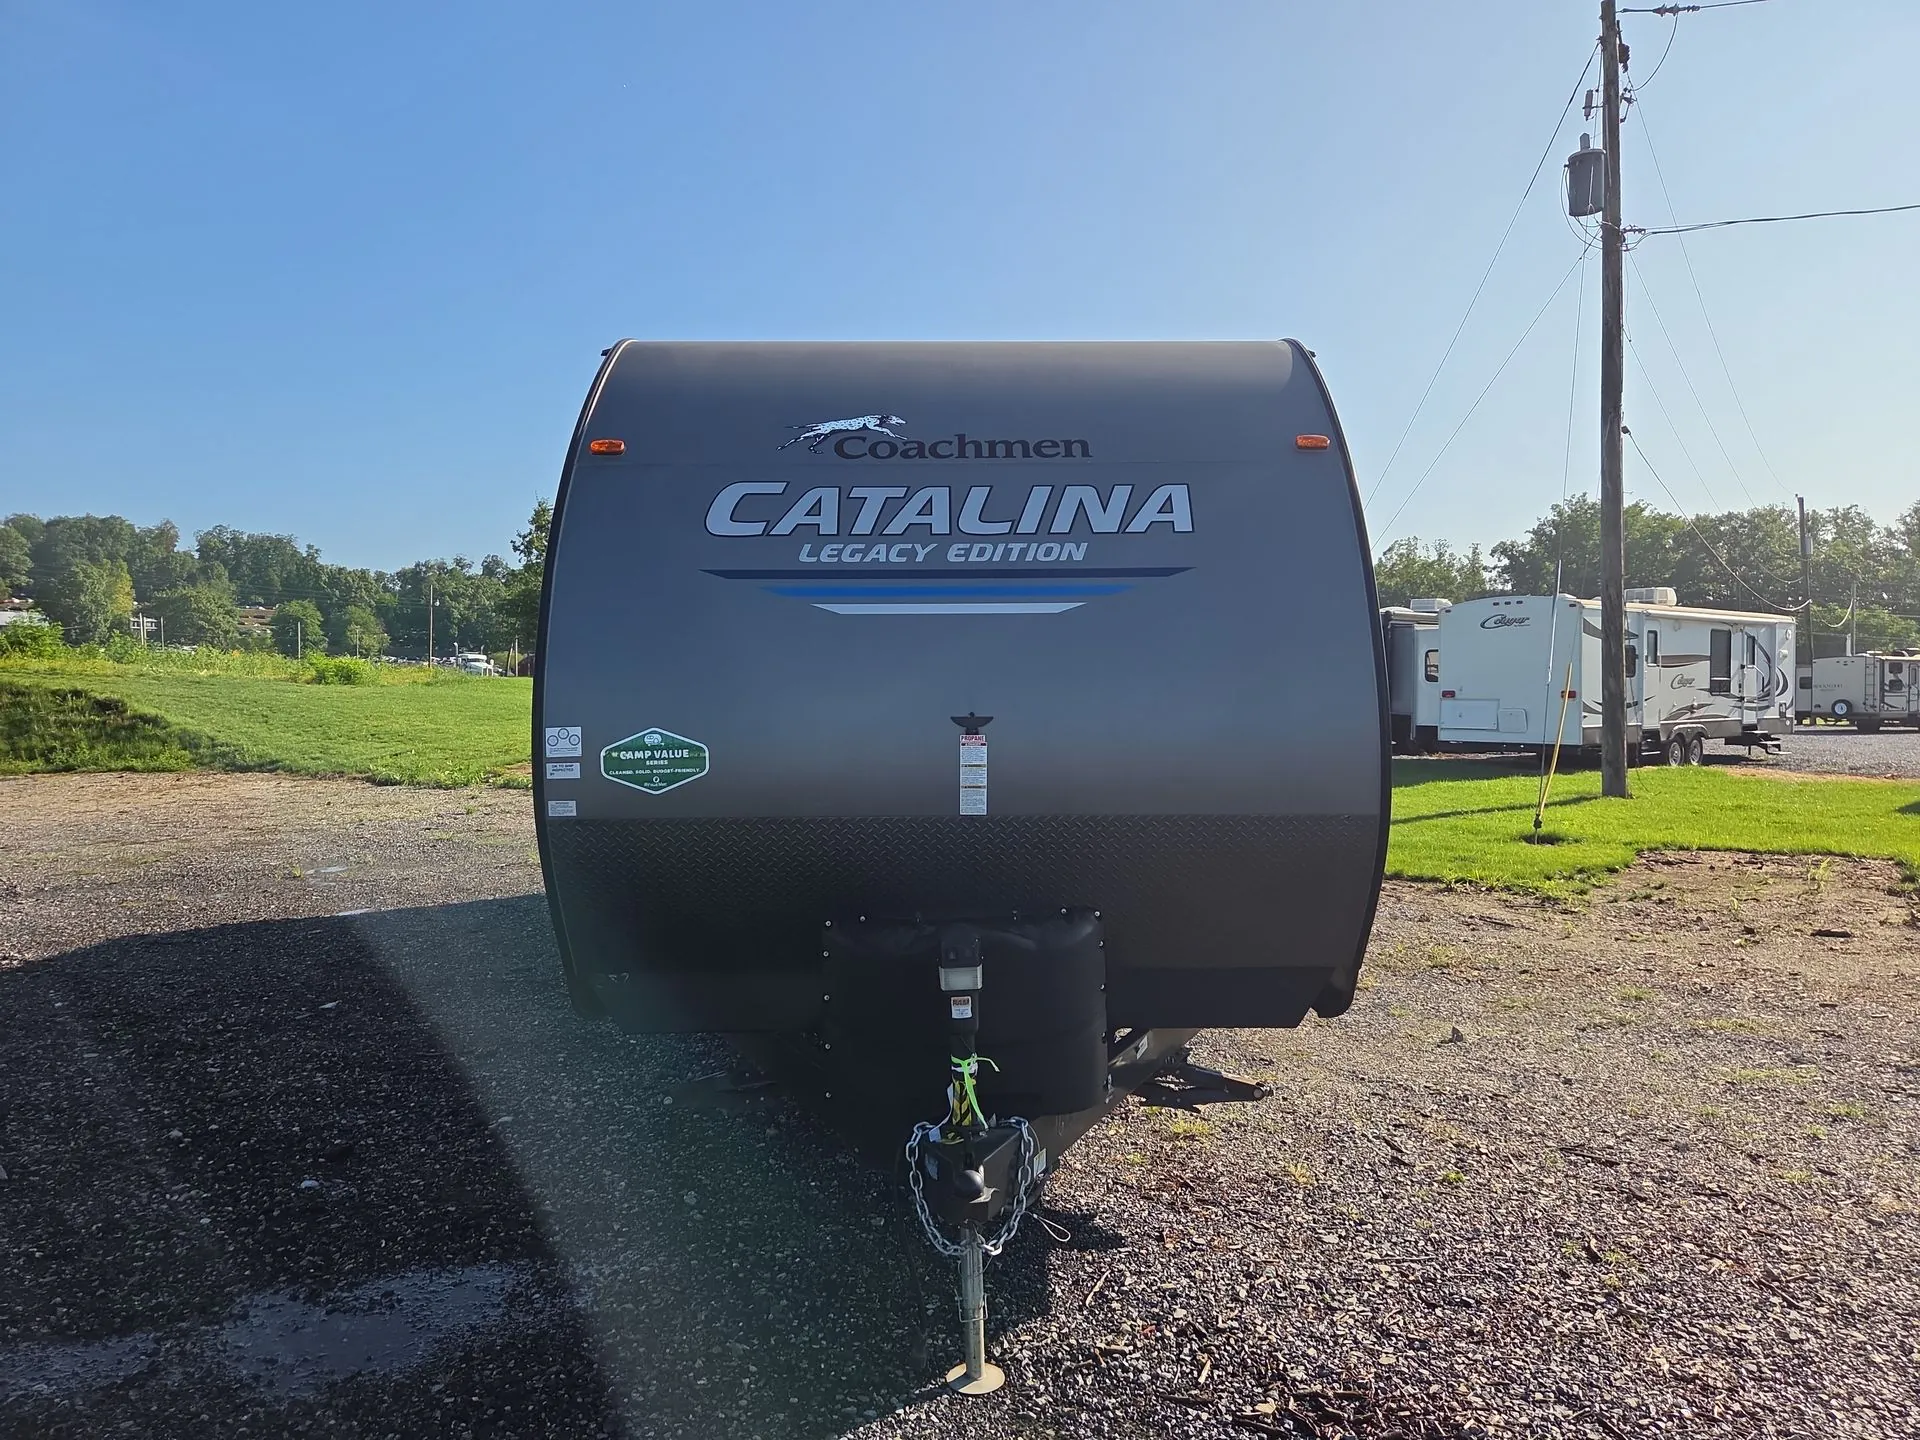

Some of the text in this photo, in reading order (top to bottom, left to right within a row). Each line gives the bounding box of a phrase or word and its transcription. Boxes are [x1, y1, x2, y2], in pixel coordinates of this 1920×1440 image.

[834, 433, 1092, 460] Coachmen
[704, 480, 1196, 537] CATALINA
[797, 541, 1088, 564] LEGACY EDITION
[619, 749, 690, 760] CAMP VALUE
